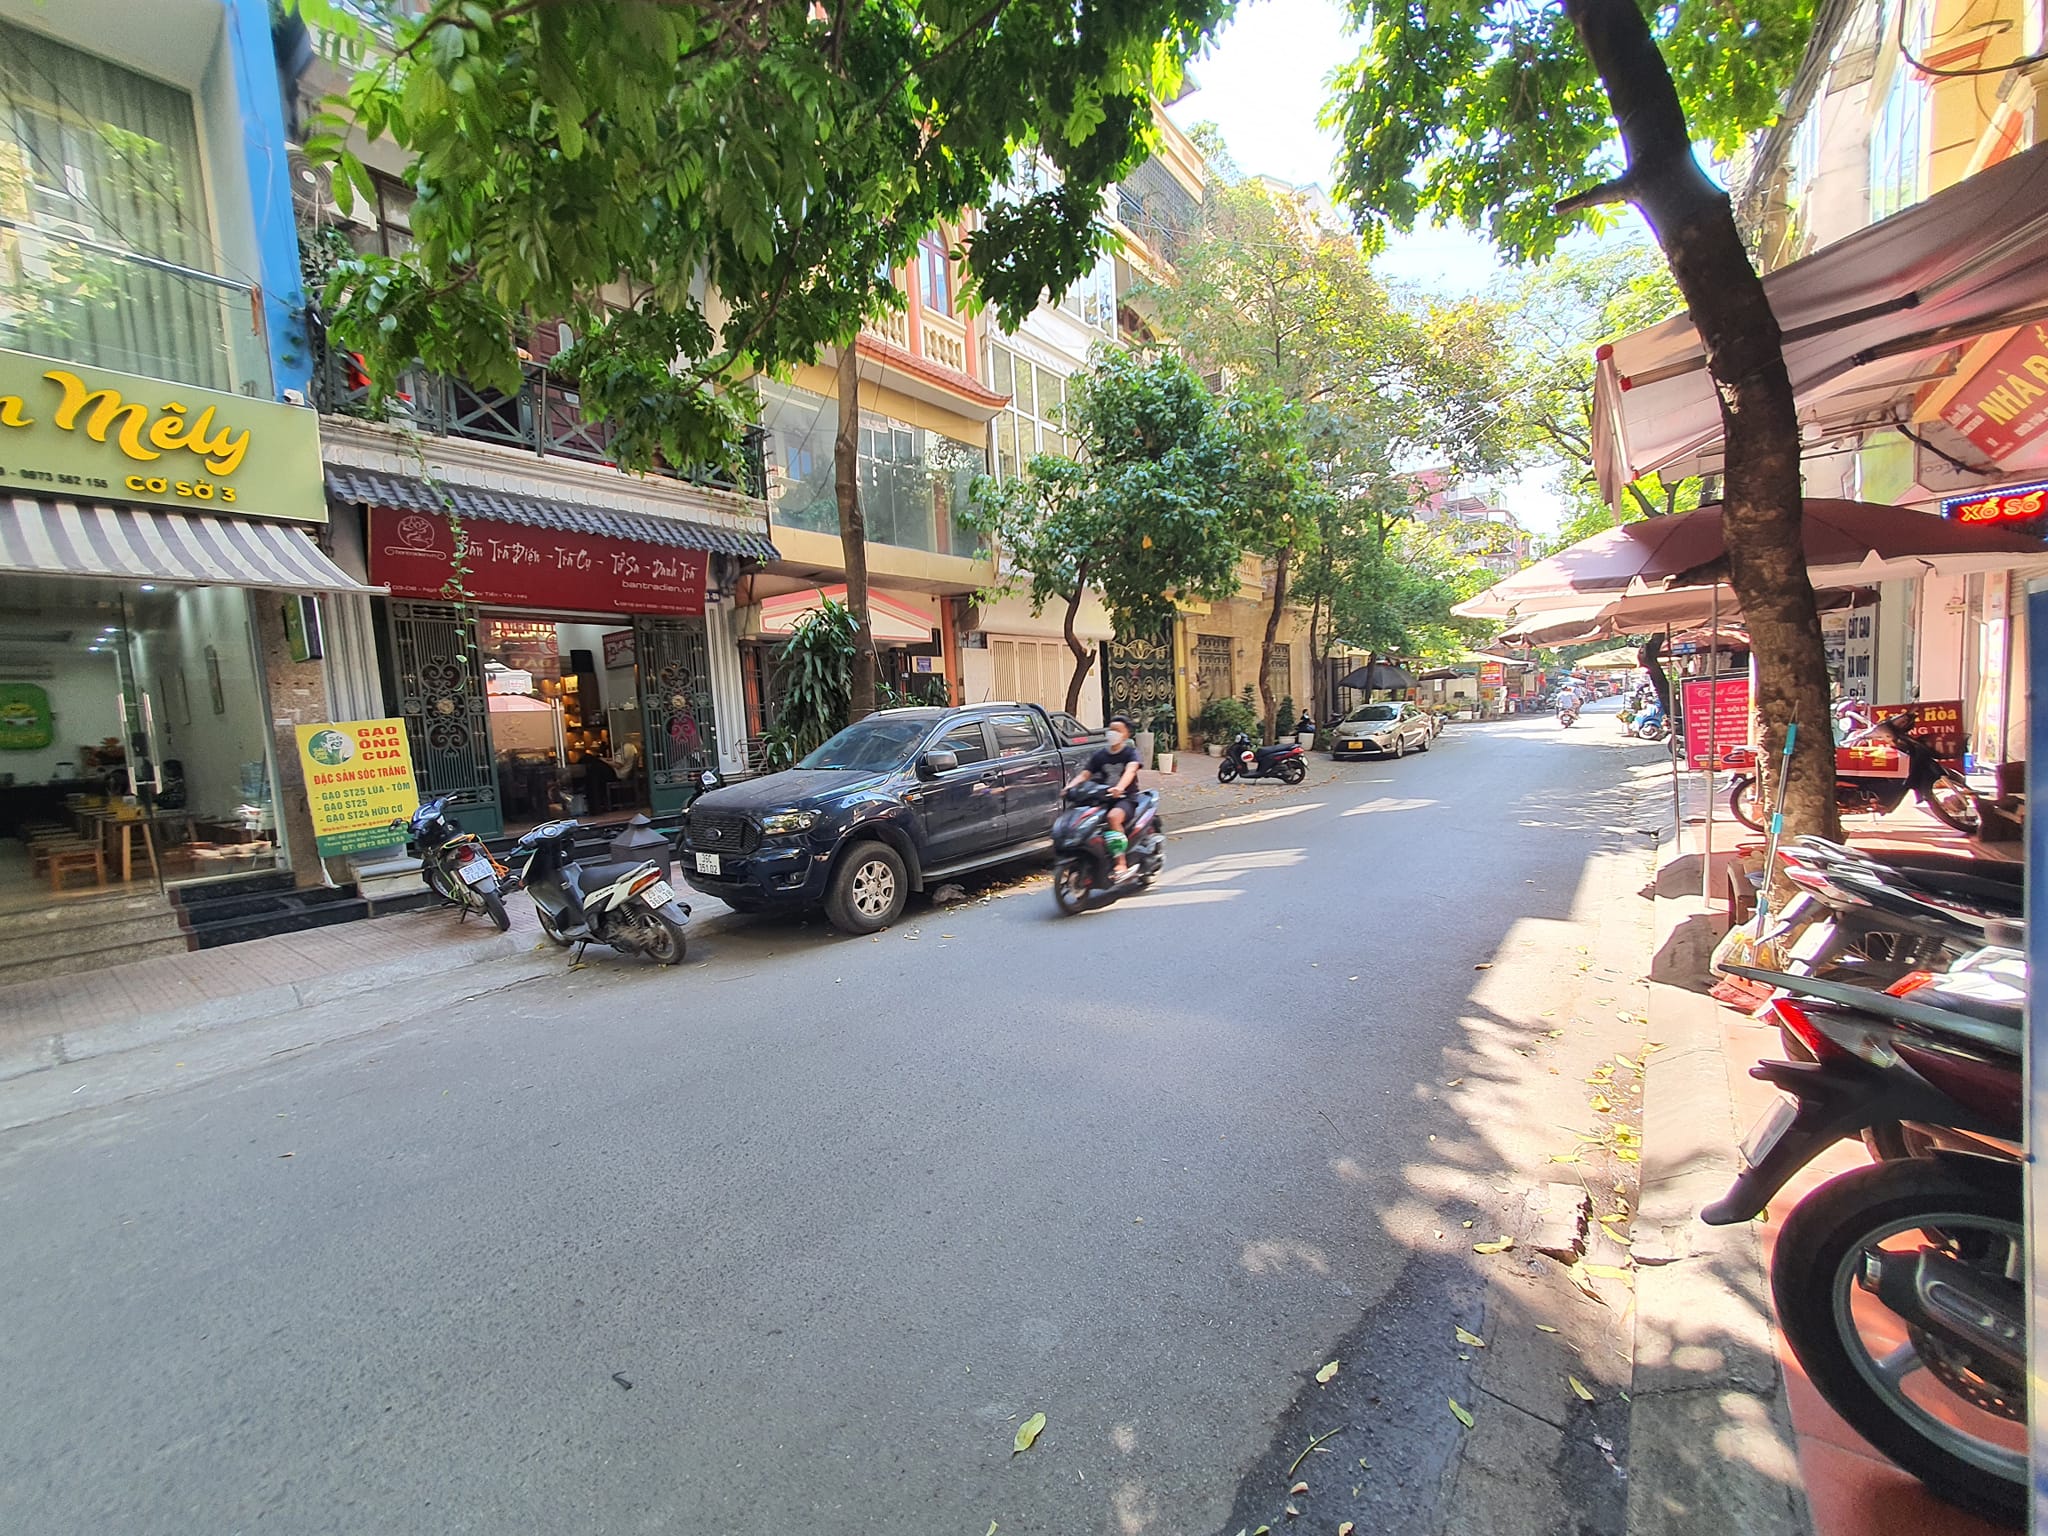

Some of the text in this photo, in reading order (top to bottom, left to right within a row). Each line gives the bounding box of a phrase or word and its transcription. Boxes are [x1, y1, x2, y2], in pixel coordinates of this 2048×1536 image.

[1977, 368, 2047, 426] NHÀ
[222, 486, 237, 502] 3
[2003, 490, 2046, 516] SỐ
[622, 579, 695, 594] bantradien.vn
[357, 726, 397, 738] GẠO
[358, 737, 400, 749] ÔNG
[362, 749, 401, 761] CUA
[321, 790, 341, 802] GẠO
[343, 787, 366, 798] ST25
[323, 798, 368, 813] GẠO ST25
[326, 813, 345, 824] GẠO
[347, 809, 370, 820] ST24
